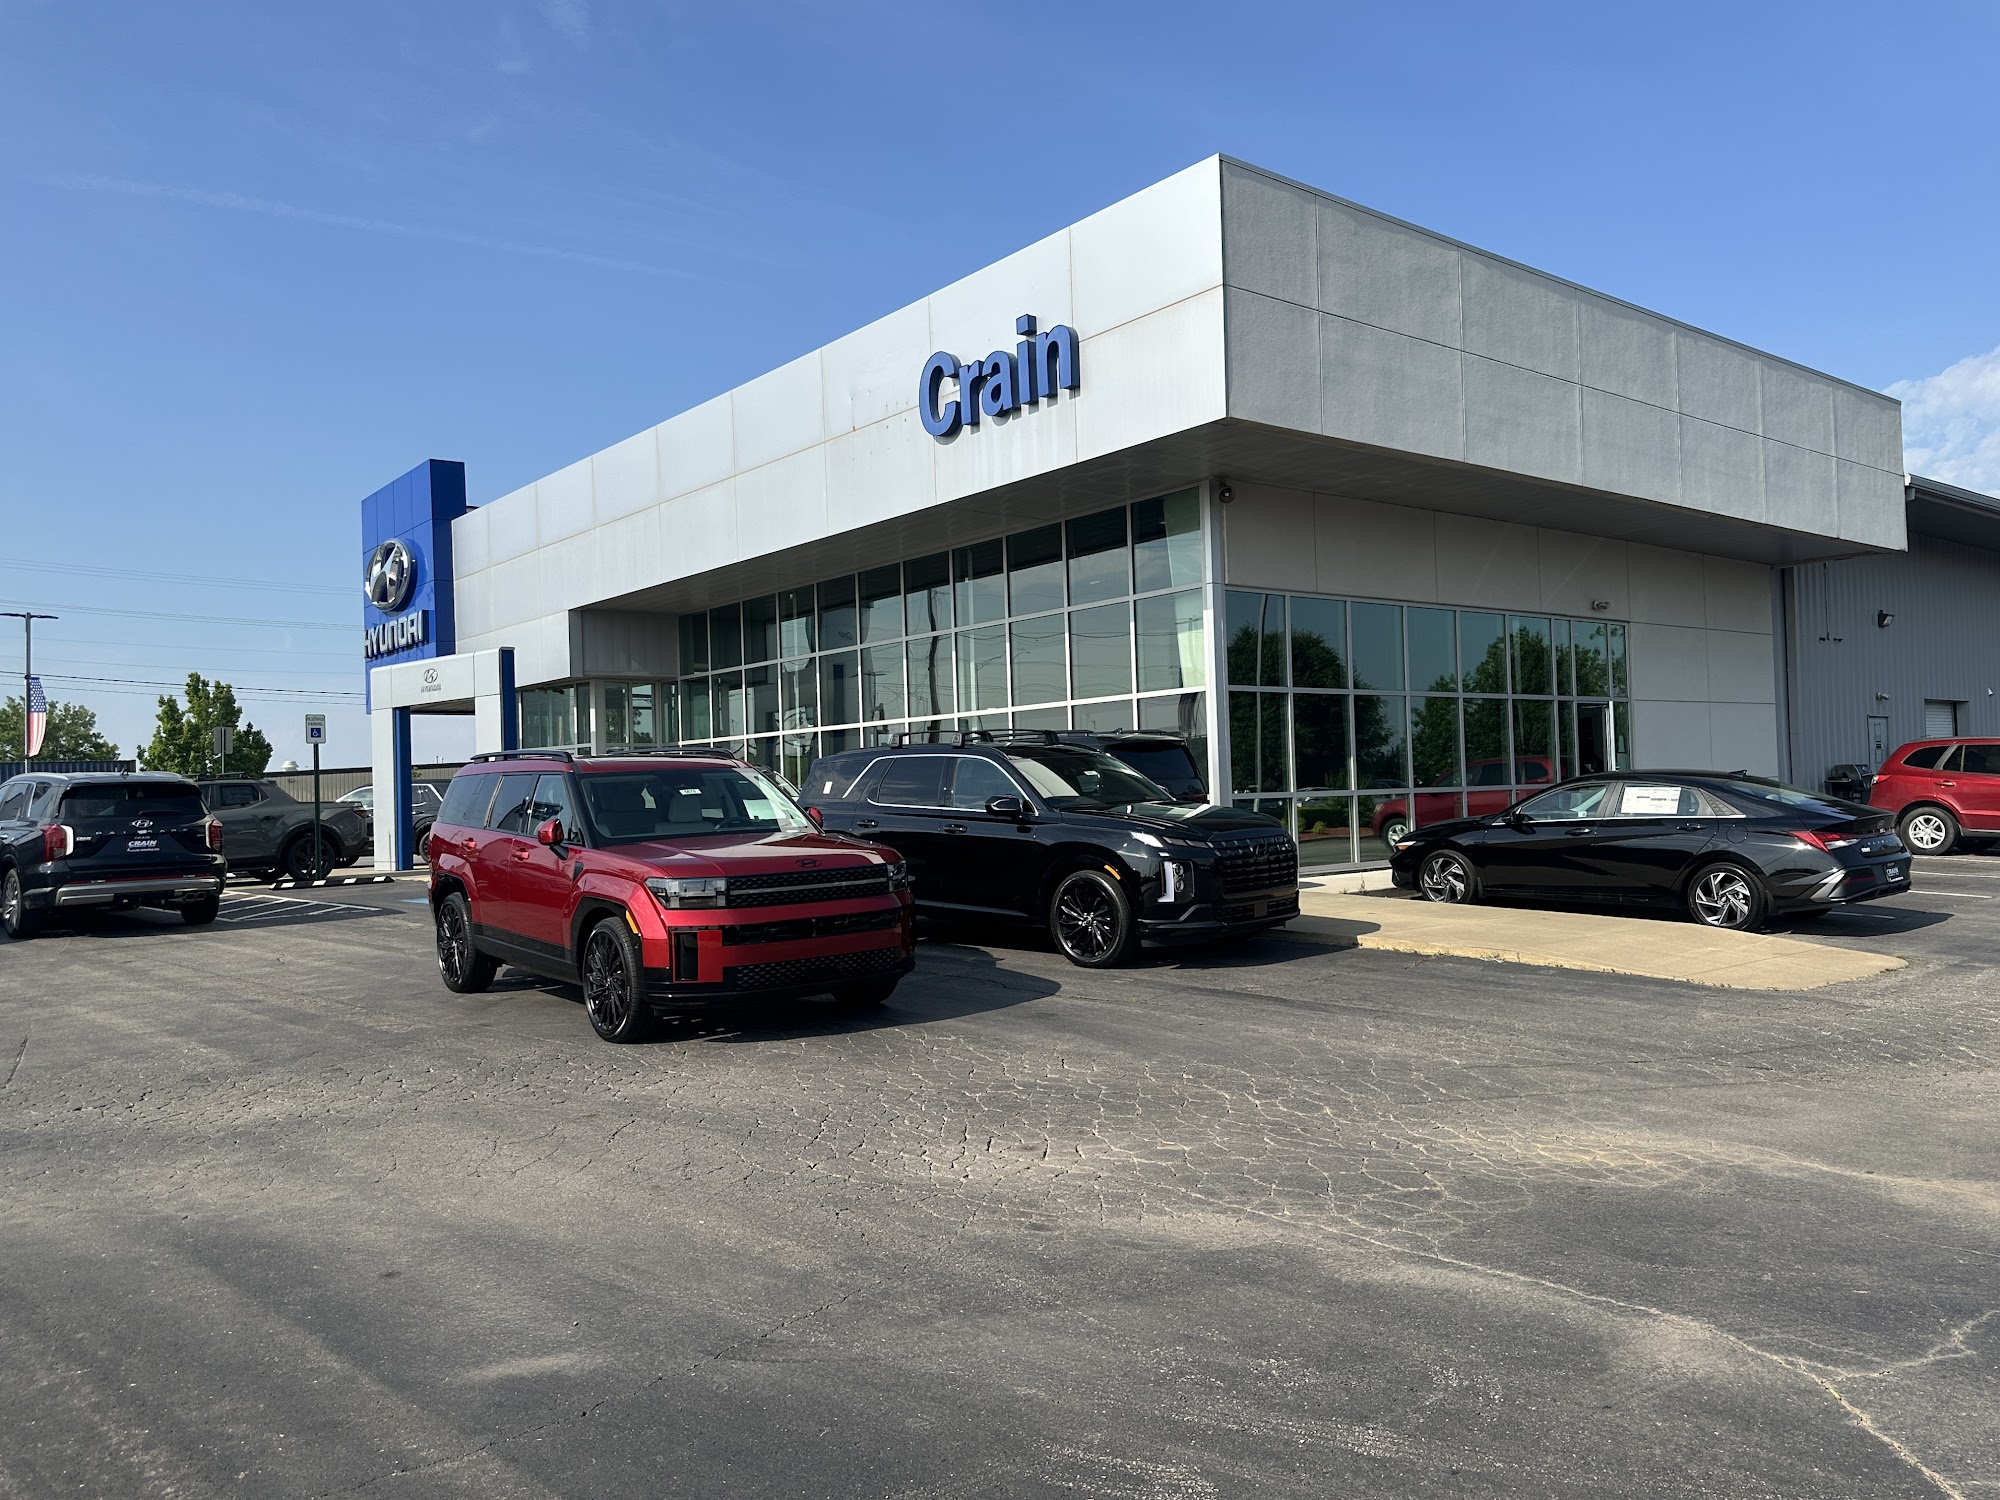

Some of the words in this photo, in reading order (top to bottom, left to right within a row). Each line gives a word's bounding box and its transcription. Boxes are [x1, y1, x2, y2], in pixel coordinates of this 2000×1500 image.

[919, 314, 1080, 436] Crain
[364, 610, 424, 659] HYUNDAI
[421, 684, 442, 693] HYUNDAI
